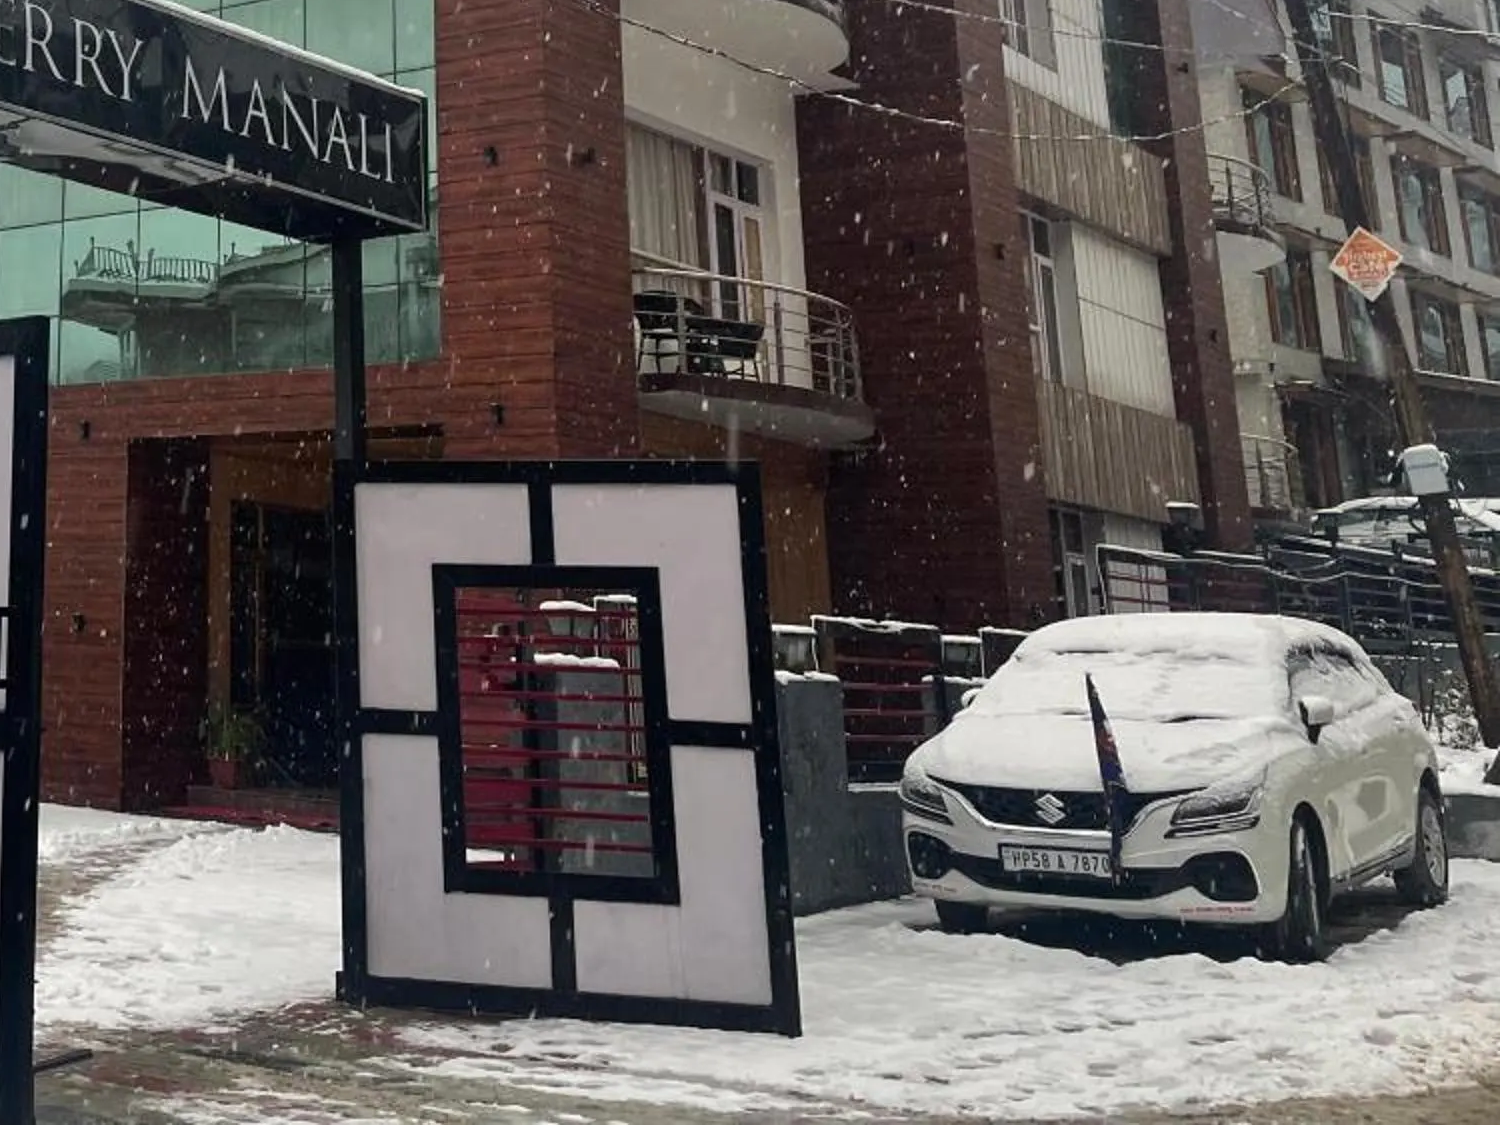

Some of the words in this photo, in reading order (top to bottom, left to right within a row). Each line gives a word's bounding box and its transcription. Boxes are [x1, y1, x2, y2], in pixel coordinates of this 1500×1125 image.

[180, 53, 395, 184] MANALI
[1011, 850, 1051, 869] HP58
[1057, 854, 1066, 870] A
